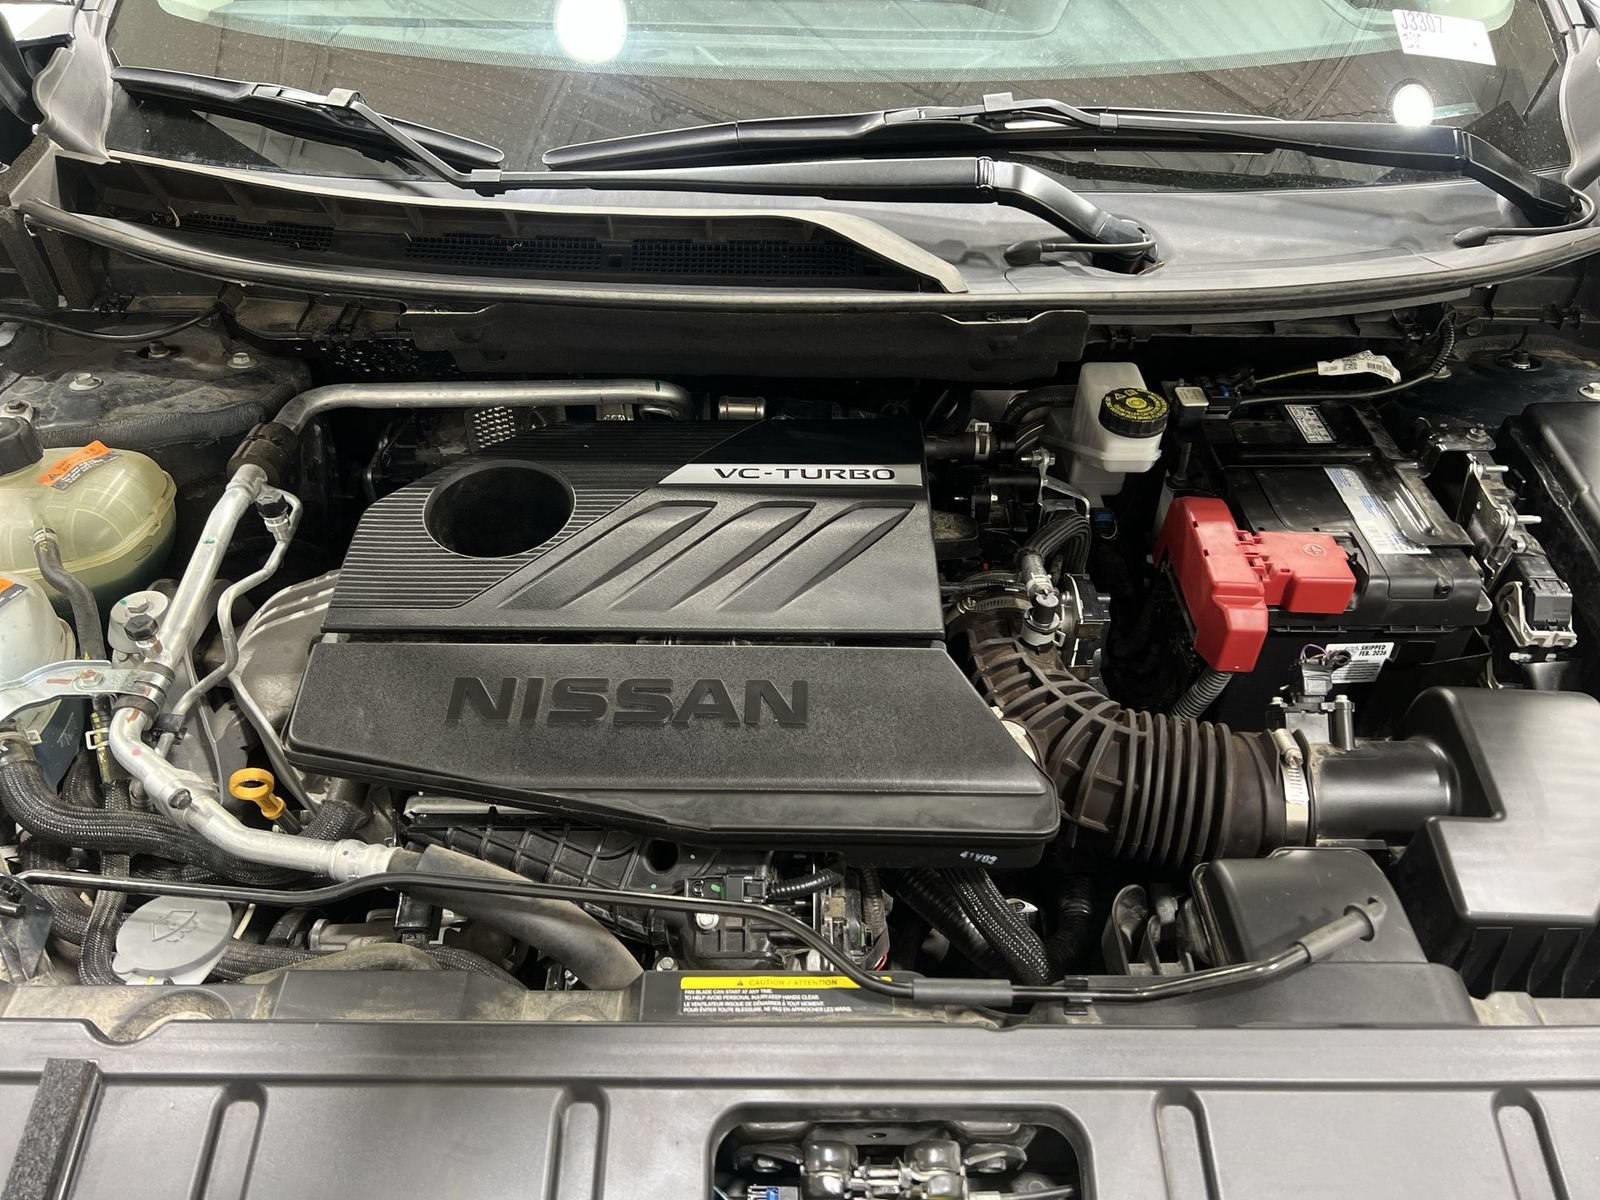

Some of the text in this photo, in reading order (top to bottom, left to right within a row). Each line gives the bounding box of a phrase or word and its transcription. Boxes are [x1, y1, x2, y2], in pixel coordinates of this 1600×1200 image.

[1401, 11, 1442, 33] J3307
[714, 467, 896, 481] VC-TURBO
[445, 676, 809, 728] NISSAN
